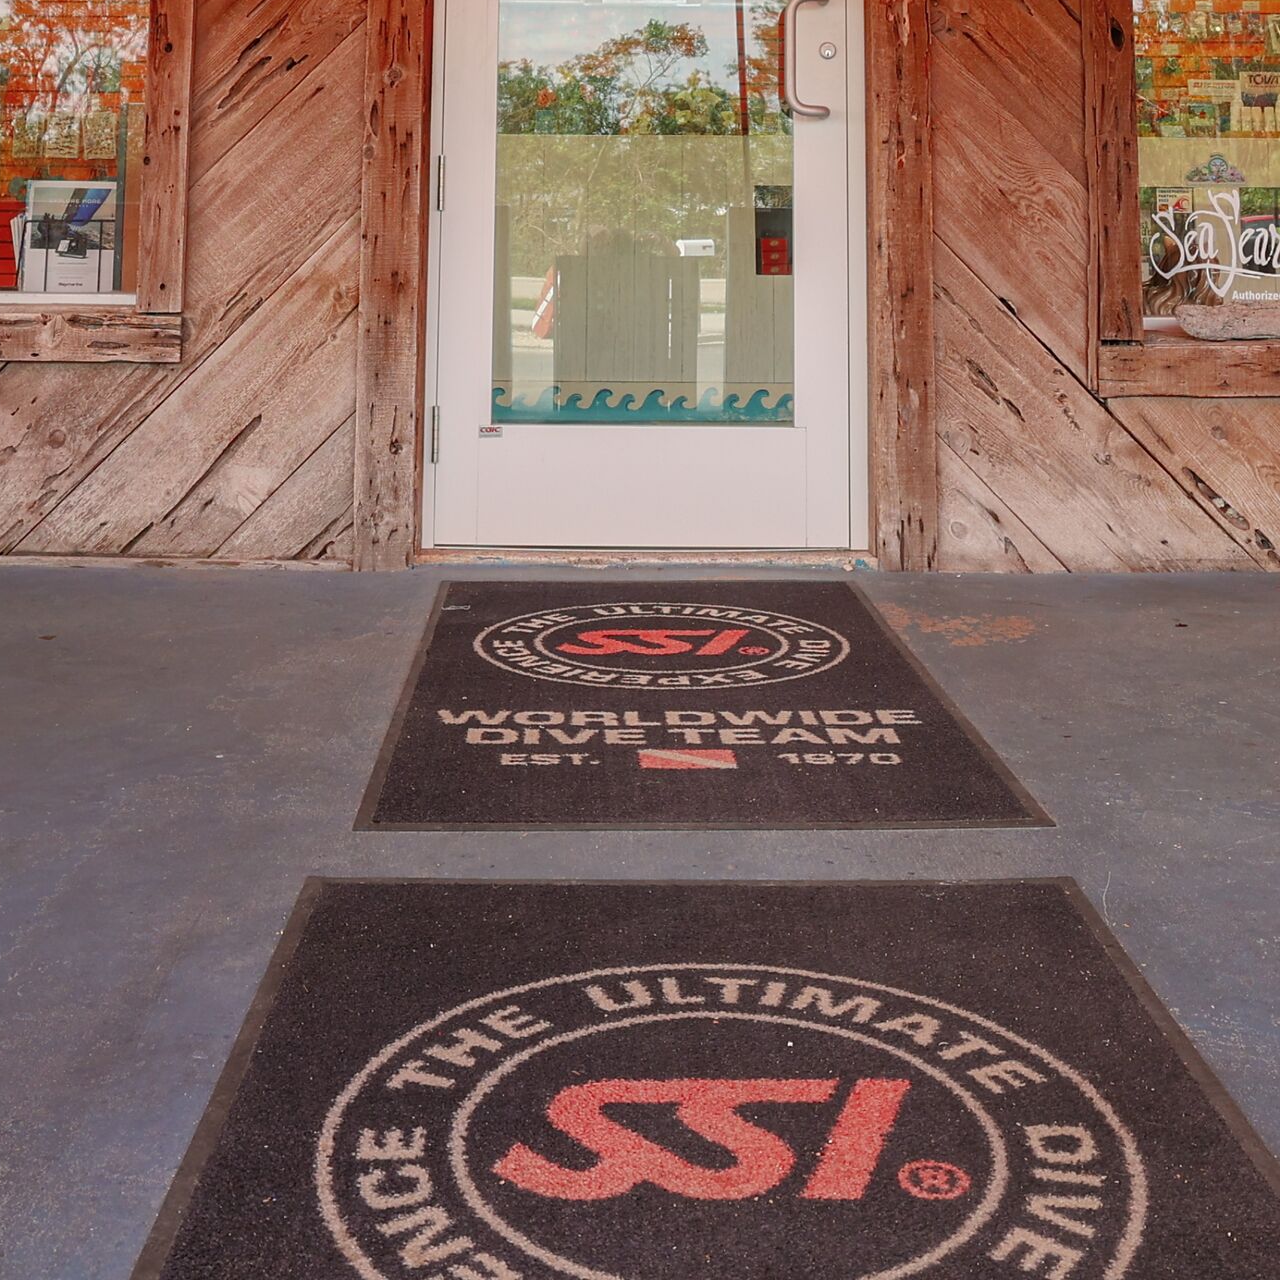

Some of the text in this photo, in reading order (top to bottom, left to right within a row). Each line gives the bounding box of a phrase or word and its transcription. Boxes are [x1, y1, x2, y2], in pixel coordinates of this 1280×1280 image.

[502, 604, 820, 686] THE ULTIMATE DIVE EXPERIENCE
[556, 629, 751, 656] SSI
[437, 710, 922, 726] WORLDWIDE
[465, 728, 902, 745] DIVE TEAM
[500, 752, 902, 766] EST. 1970
[386, 1004, 552, 1091] THE
[584, 976, 1049, 1094] ULTIMATE
[990, 1123, 1104, 1280] DIVE
[491, 1076, 911, 1200] SSI
